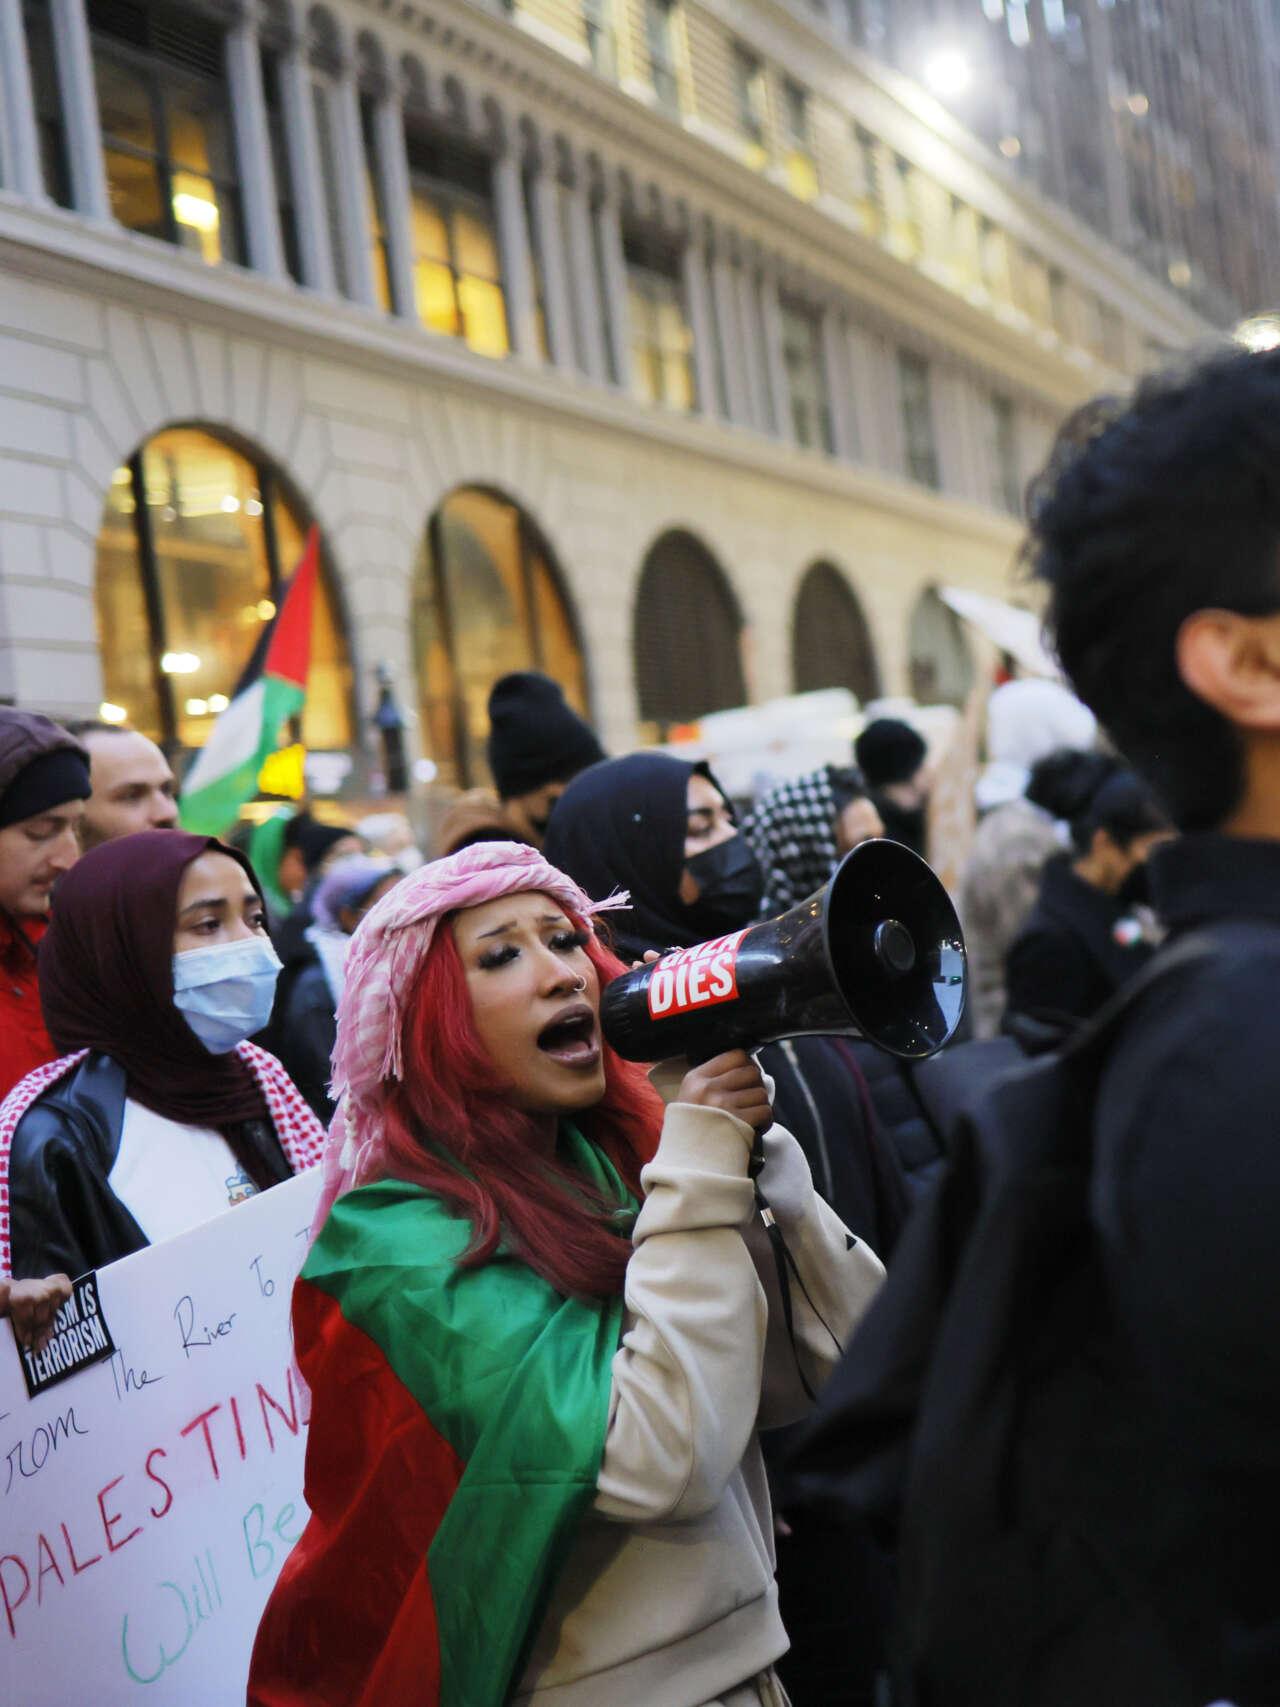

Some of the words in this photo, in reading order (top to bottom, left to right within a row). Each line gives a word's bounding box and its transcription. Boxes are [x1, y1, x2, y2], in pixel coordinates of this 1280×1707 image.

[651, 951, 733, 1014] DIES
[25, 1313, 108, 1387] TERRORISM
[80, 1282, 97, 1318] IS
[101, 1347, 164, 1401] The
[173, 1295, 237, 1359] River
[249, 1254, 275, 1297] To
[0, 1367, 299, 1638] PALESTIN
[122, 1547, 222, 1685] Will
[243, 1502, 303, 1580] Be
